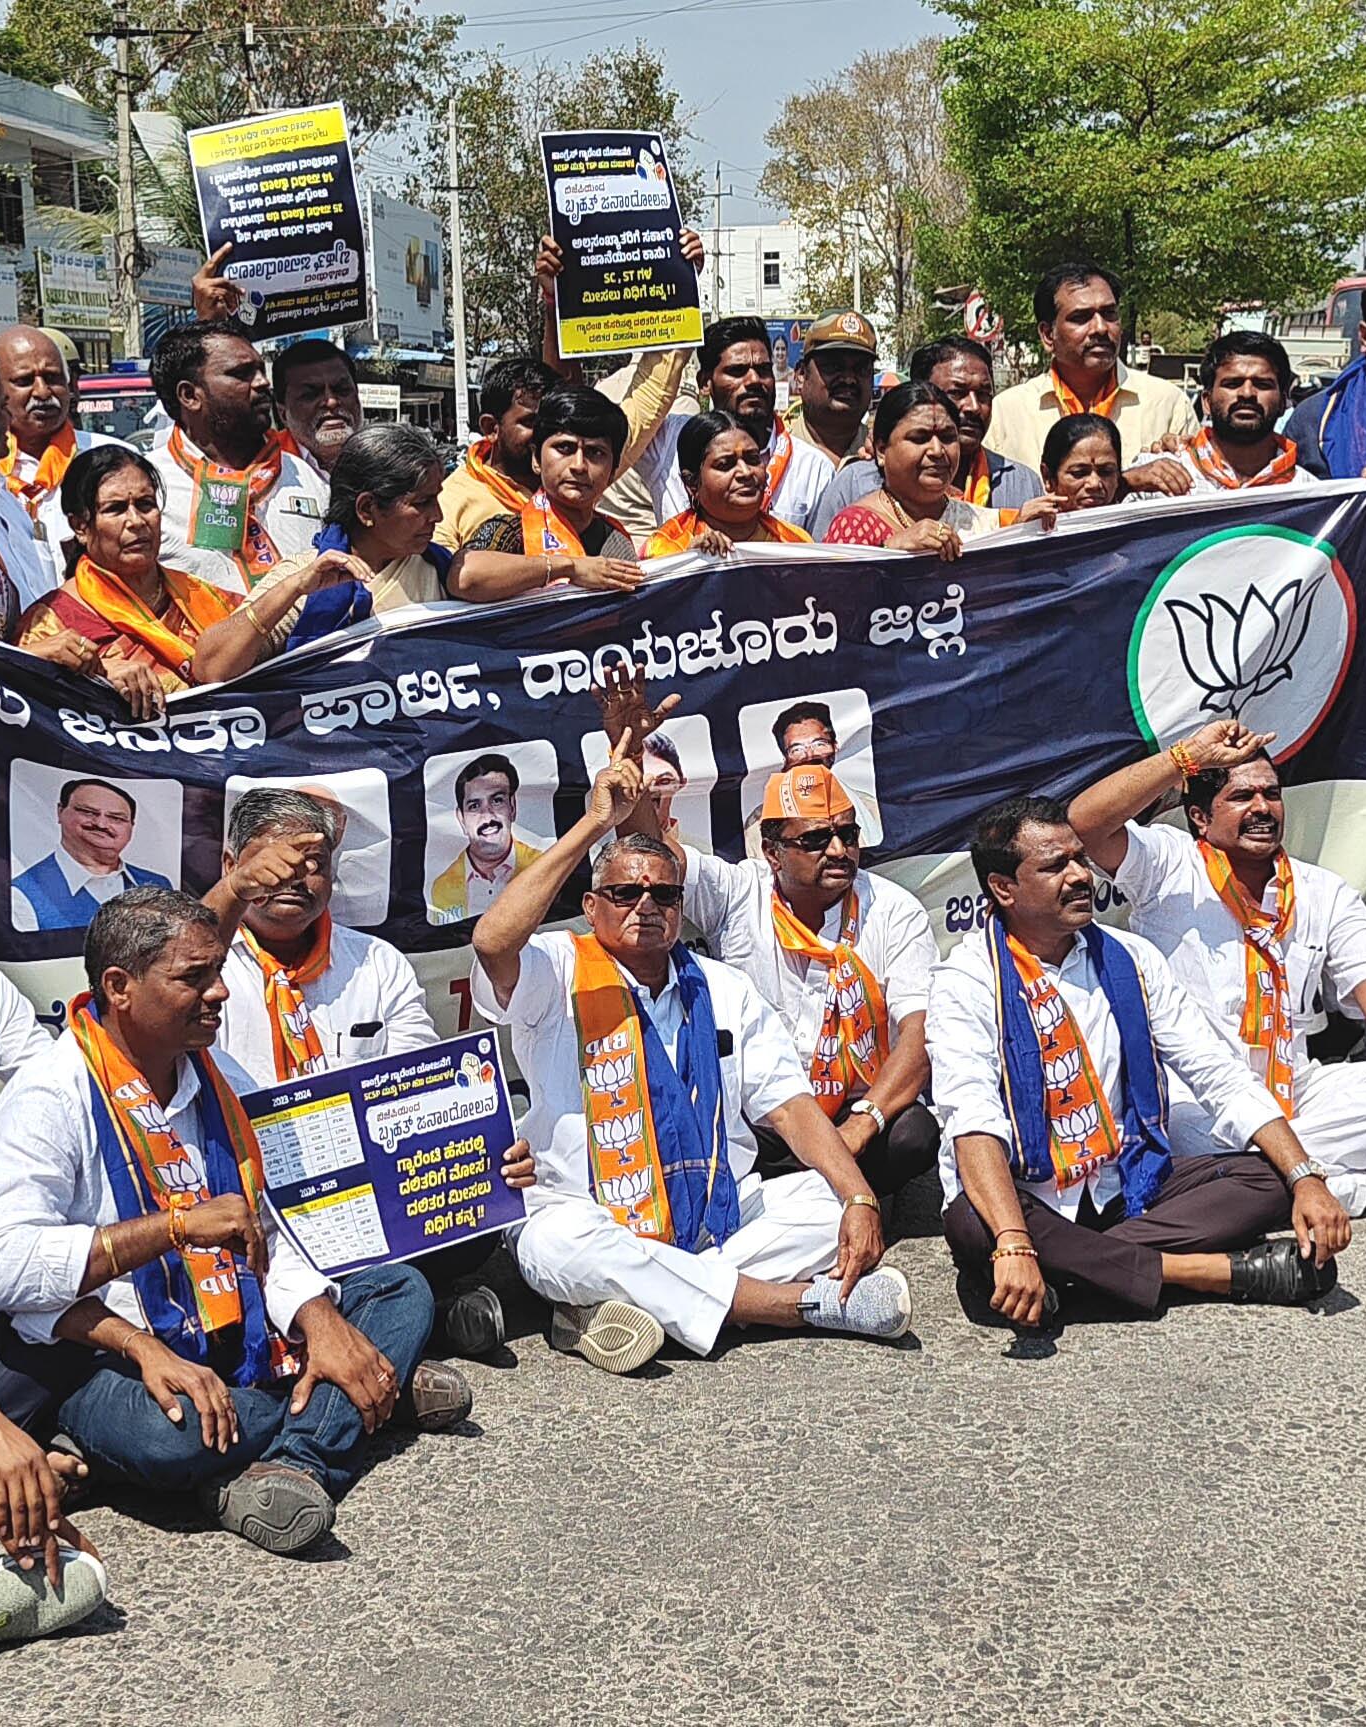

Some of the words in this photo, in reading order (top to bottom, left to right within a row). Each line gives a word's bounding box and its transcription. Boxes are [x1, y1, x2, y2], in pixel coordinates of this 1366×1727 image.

[322, 172, 334, 182] 14
[565, 194, 598, 222] ಬೃಹತ್
[601, 190, 668, 210] ಜನಾಂದೋಲನ
[228, 256, 311, 280] ಜನಾಂದೋಲನ
[582, 290, 621, 303] ಮೀಸಲು
[623, 285, 648, 301] ನಿಧಿಗೆ
[77, 401, 113, 413] POLICE
[58, 706, 266, 753] ಜನತಾ
[517, 594, 839, 699] ರಾಯಚೂರು
[868, 583, 967, 660] ಜಿಲ್ಲೆ
[1026, 975, 1051, 1001] JP
[813, 1080, 844, 1097] BJP
[379, 1117, 413, 1149] ಬೃಹತ್
[416, 1096, 494, 1131] ಜನಾಂದೋಲನ
[396, 1147, 441, 1176] ಗ್ಯಾರೆಂಟಿ
[443, 1135, 486, 1159] ಹೆಸರಲ್ಲಿ
[399, 1167, 447, 1196] ದಲಿತರಿಗೆ
[406, 1191, 446, 1217] ದಲಿತರ
[448, 1180, 492, 1204] ಮೀಸಲು
[424, 1211, 453, 1236] ನಿಧಿಗೆ
